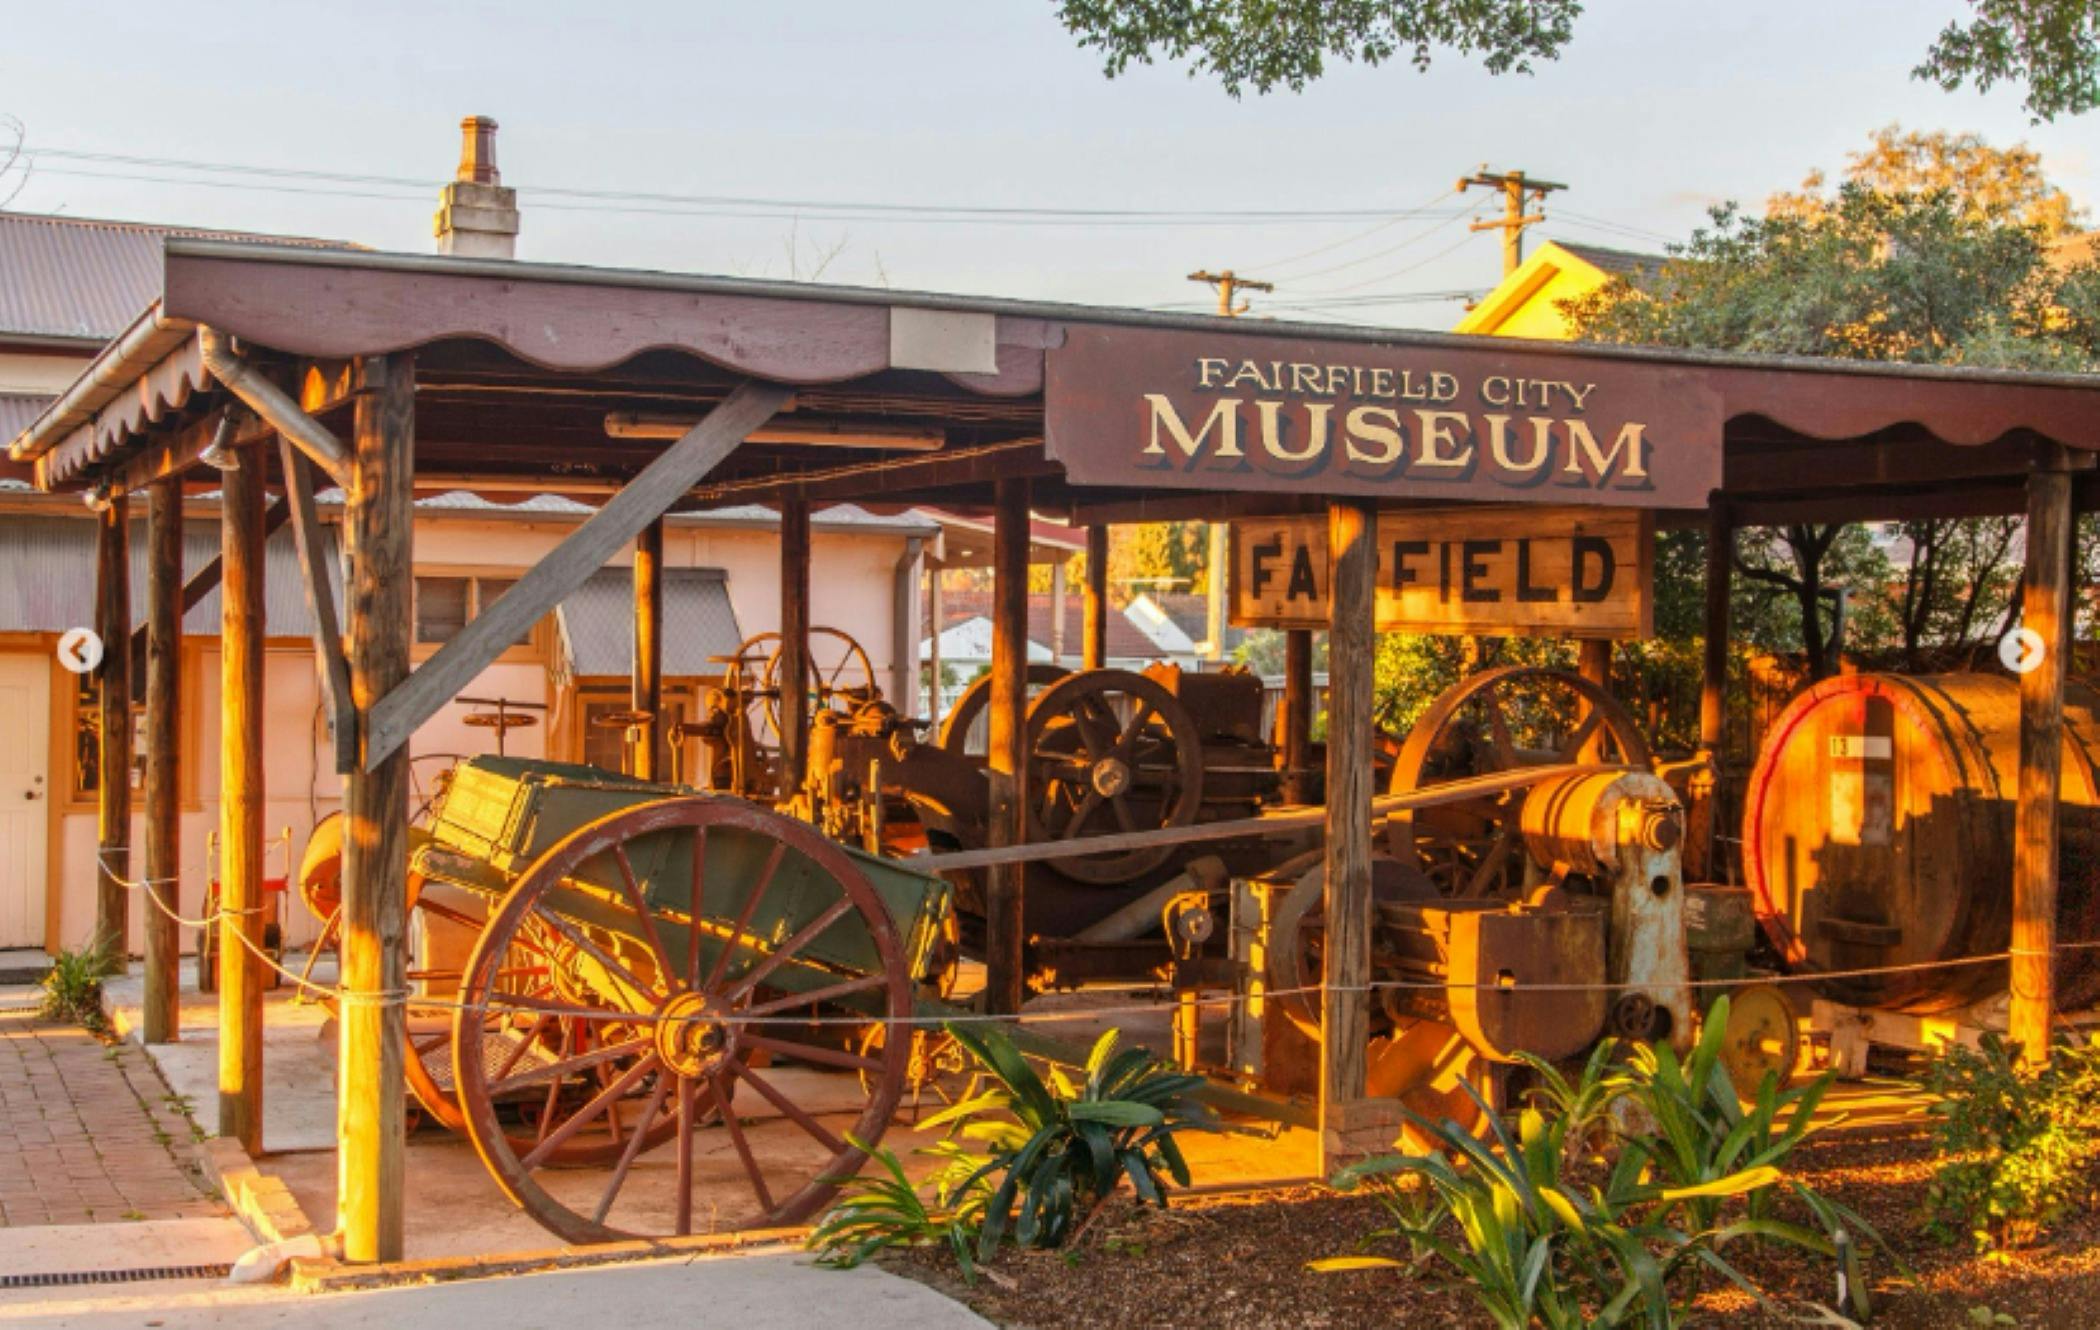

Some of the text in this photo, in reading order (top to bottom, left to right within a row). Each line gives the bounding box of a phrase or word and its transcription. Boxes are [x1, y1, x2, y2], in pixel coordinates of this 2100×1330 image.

[1196, 357, 1597, 411] FAIRFIELD CITY
[1141, 393, 1650, 478] MUSEUM
[1252, 535, 1616, 604] FAFIELD
